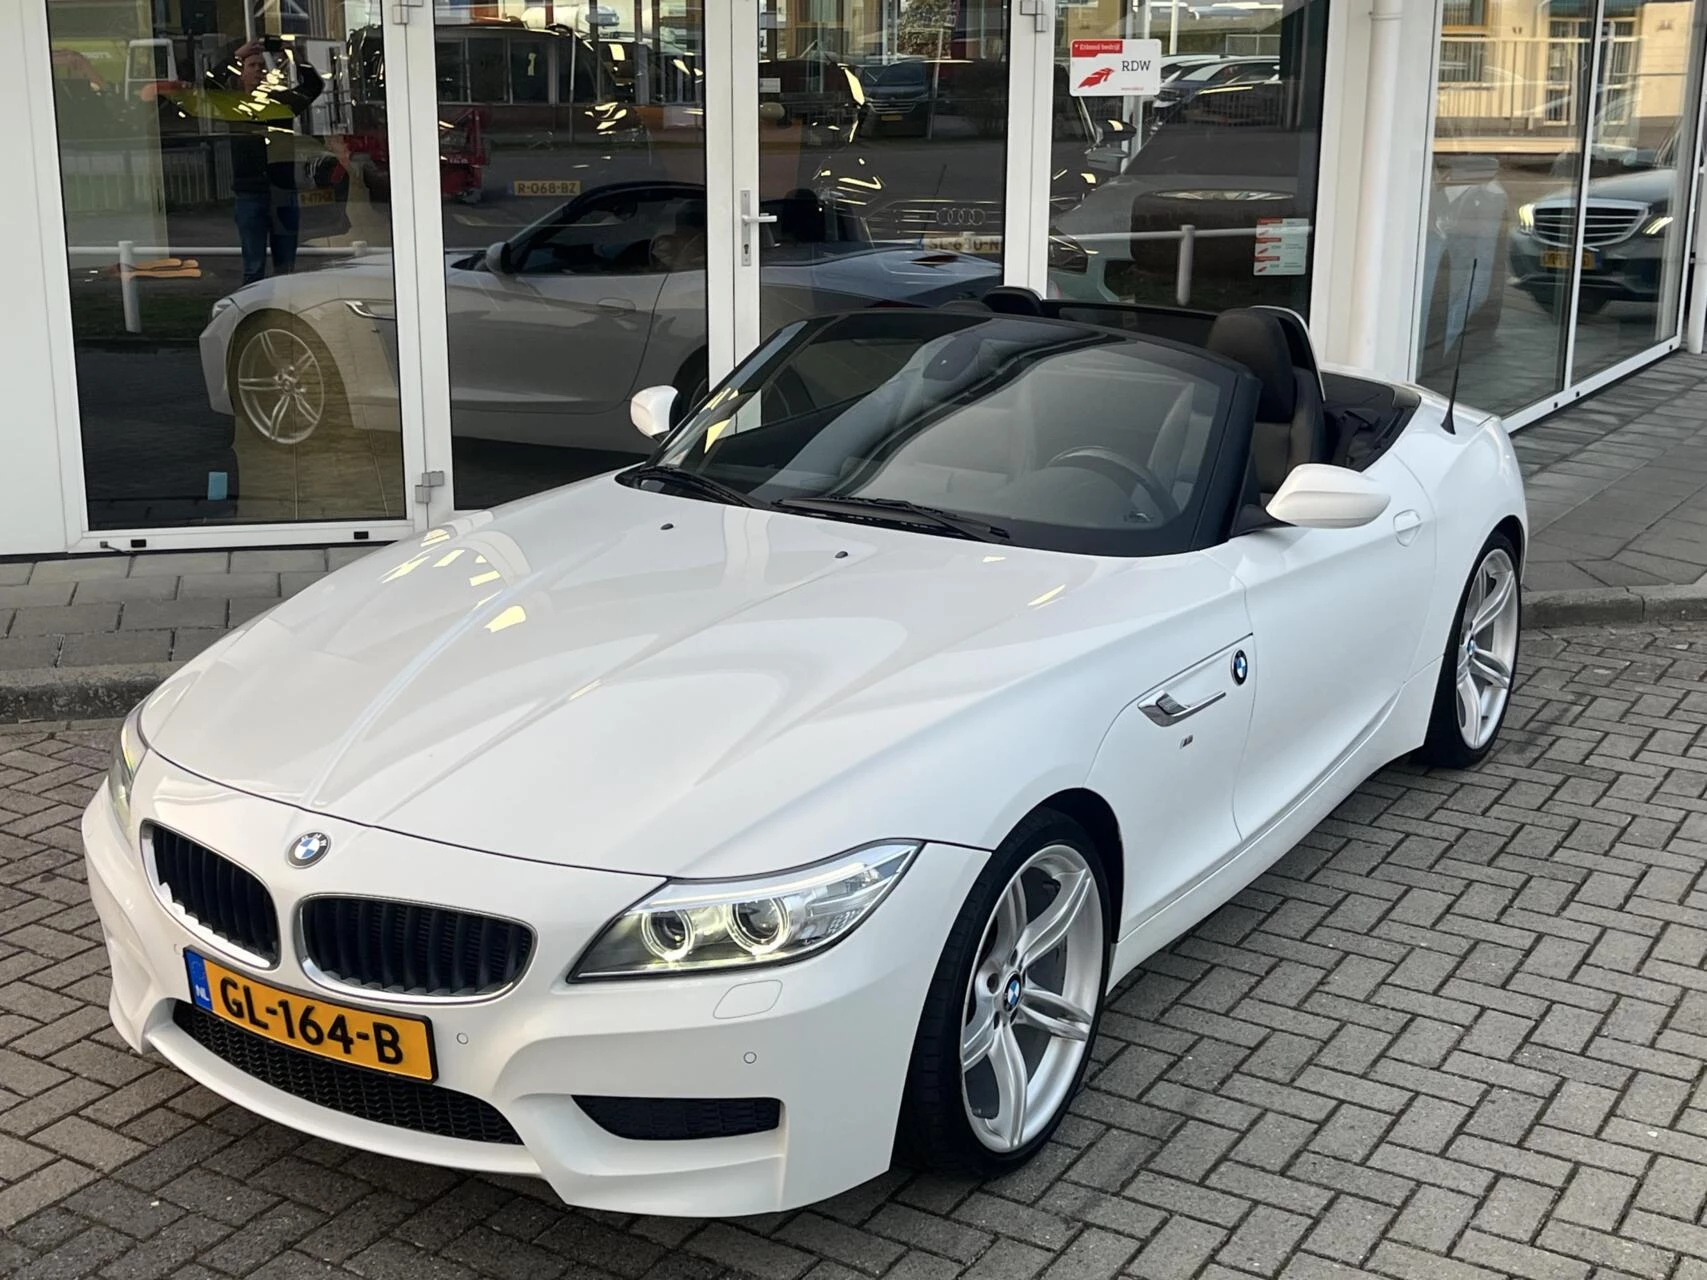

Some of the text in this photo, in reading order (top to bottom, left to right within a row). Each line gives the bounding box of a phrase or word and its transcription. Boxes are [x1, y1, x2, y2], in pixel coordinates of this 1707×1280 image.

[1121, 60, 1151, 72] RDW
[195, 984, 210, 1001] NL
[219, 976, 403, 1065] GL-164-B
